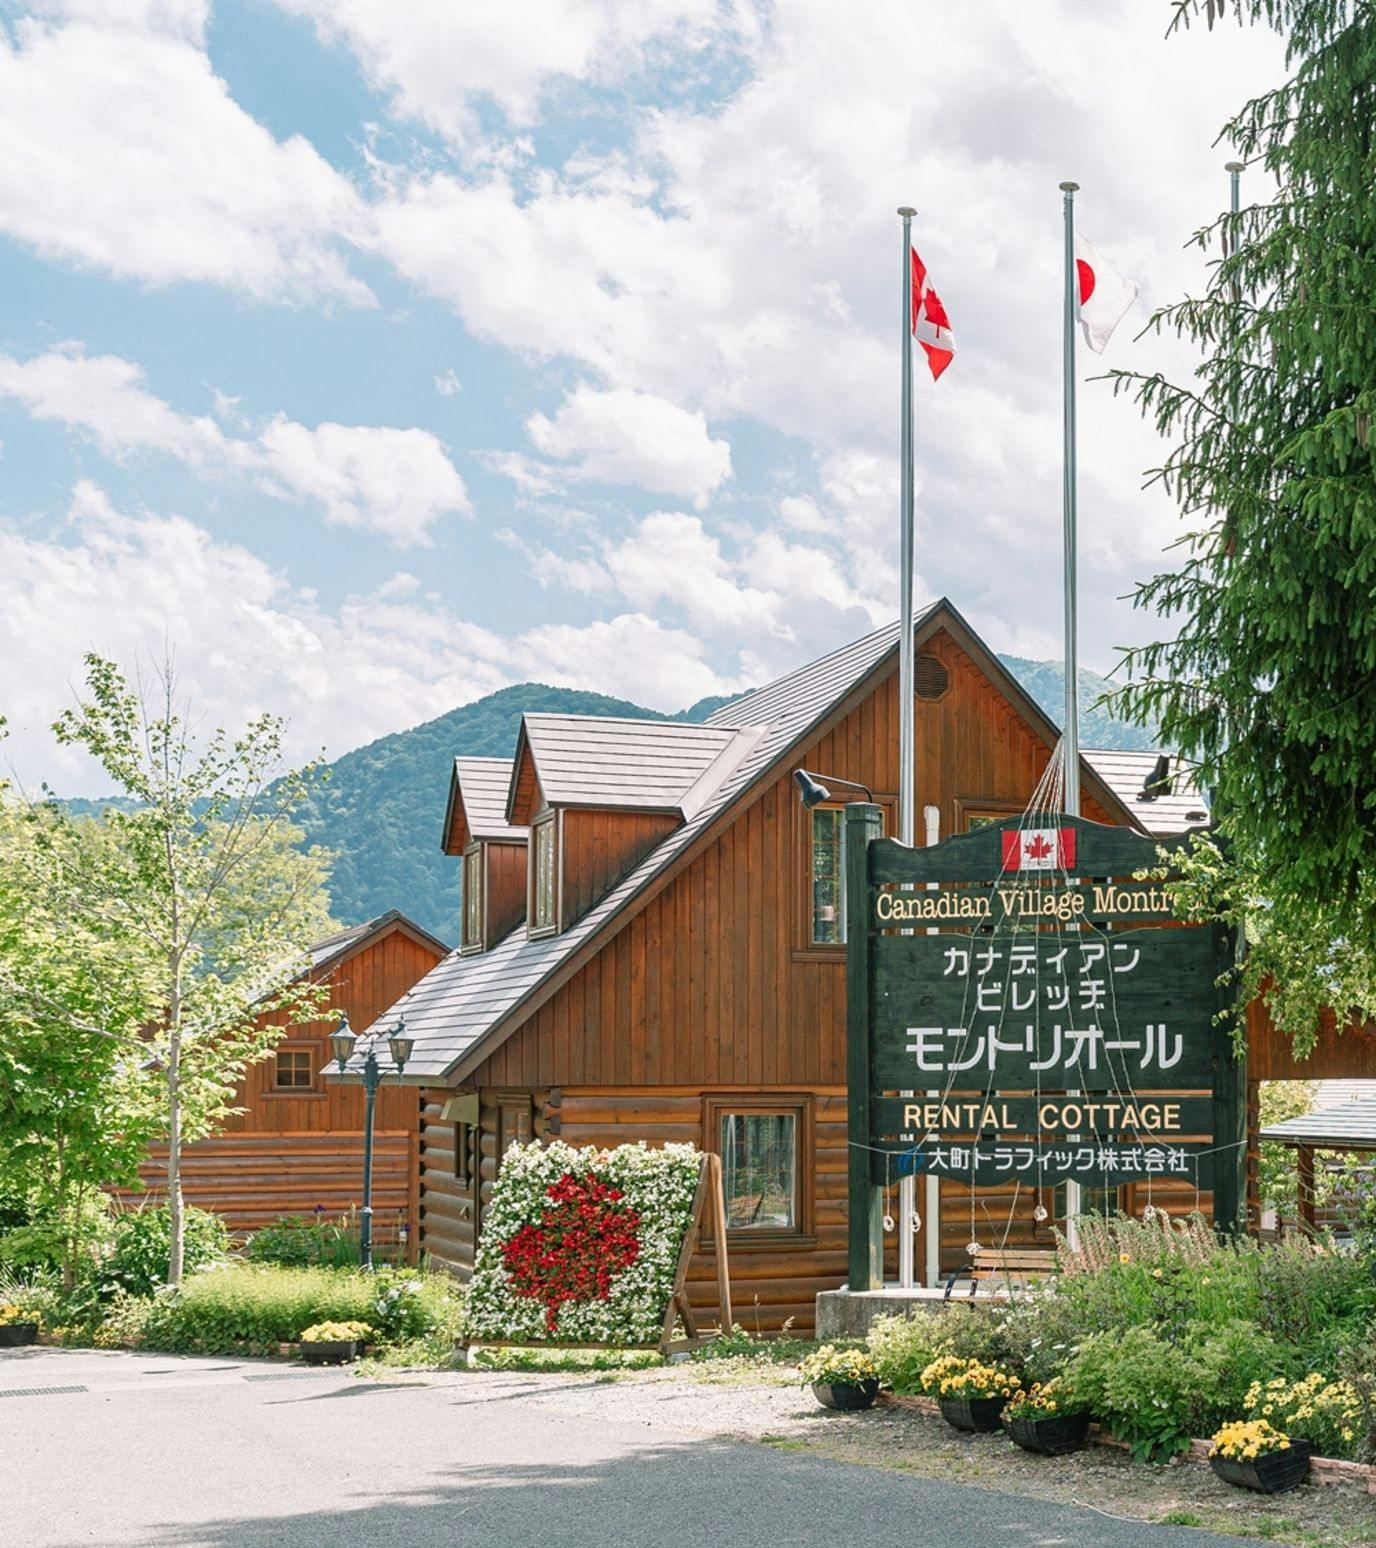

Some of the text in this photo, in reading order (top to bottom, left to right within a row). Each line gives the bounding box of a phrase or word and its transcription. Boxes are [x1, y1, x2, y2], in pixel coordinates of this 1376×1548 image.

[877, 886, 992, 919] Canadian
[998, 884, 1085, 922] Village
[943, 943, 1140, 975] カナディアン
[975, 980, 1106, 1011] ビレッヂ
[905, 1024, 1183, 1071] モントリオール
[904, 1104, 1181, 1130] RENTAL COTTAGE
[928, 1147, 1189, 1172] 大町トラフィック株式会社
